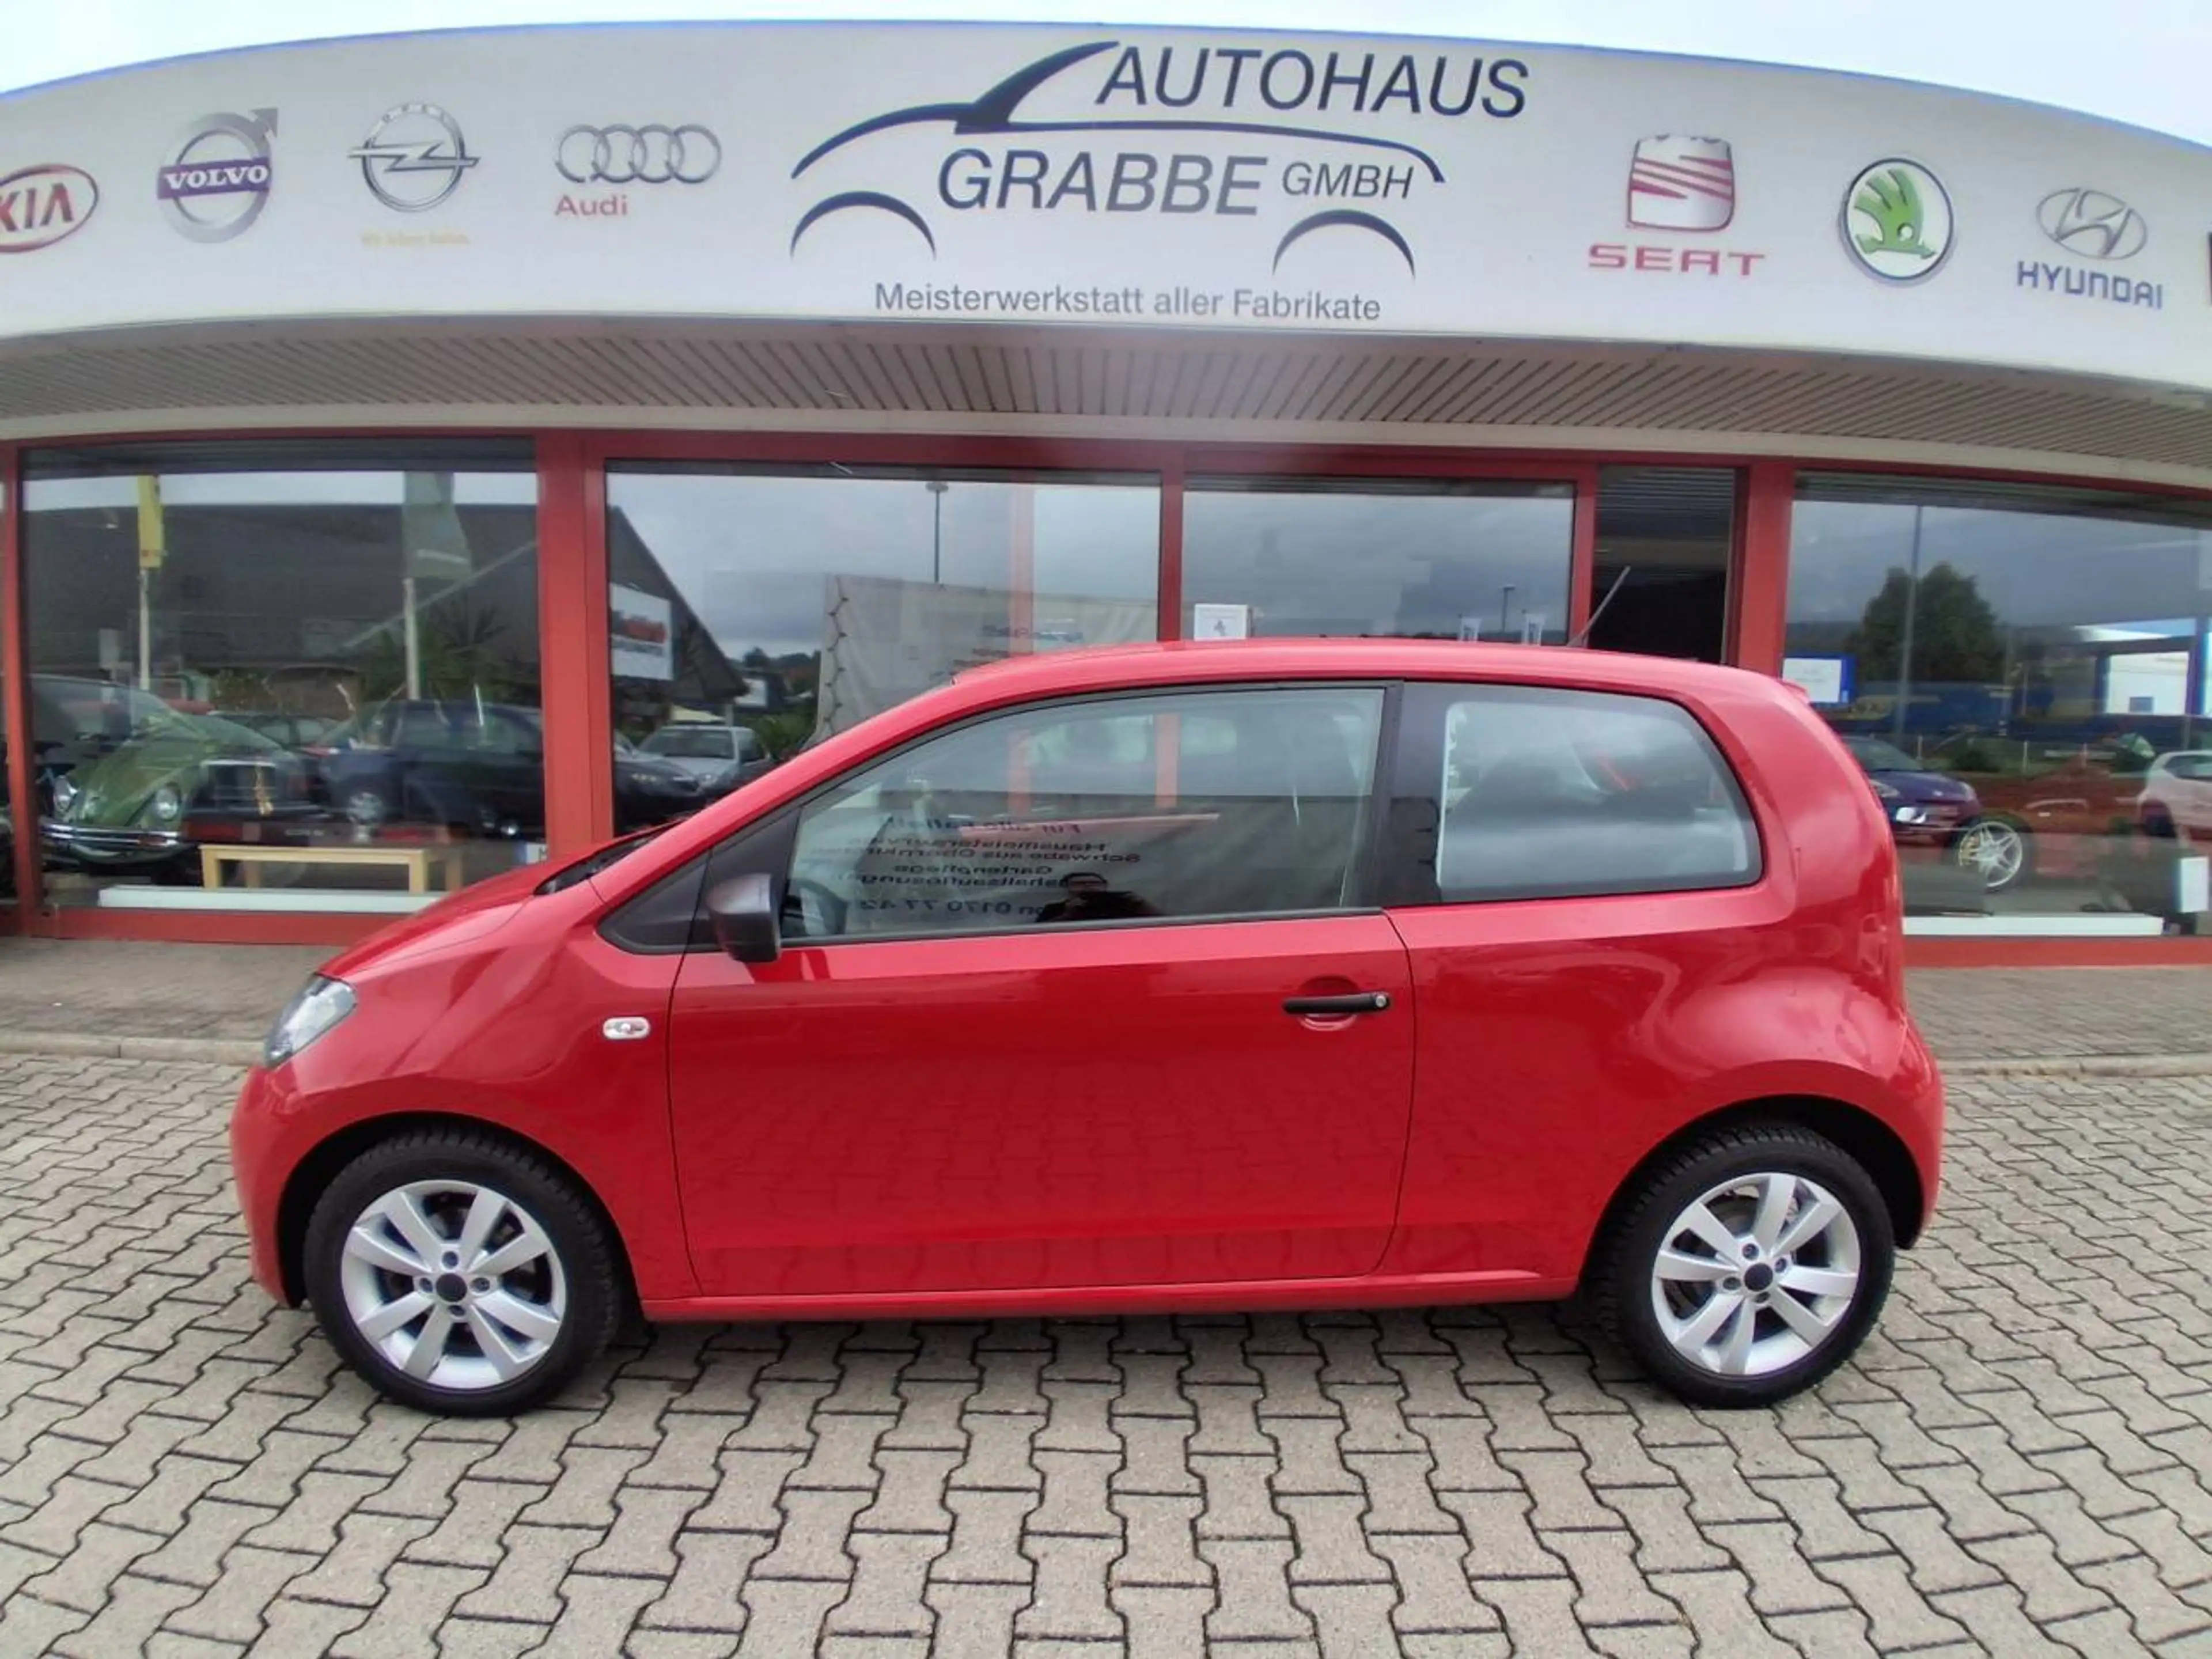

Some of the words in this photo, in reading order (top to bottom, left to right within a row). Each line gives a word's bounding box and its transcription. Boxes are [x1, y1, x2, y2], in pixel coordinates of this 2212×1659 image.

[1096, 46, 1529, 118] AUTOHAUS
[165, 166, 269, 191] VOLVO
[938, 148, 1268, 215] GRABBE
[1282, 162, 1415, 199] GMBH
[0, 183, 73, 232] KIA
[555, 195, 629, 216] Audi
[1589, 244, 1765, 276] SEAT
[875, 283, 1143, 316] Meisterwerkstatt
[1154, 287, 1224, 317] aller
[1233, 289, 1381, 321] Fabrikate
[2017, 260, 2163, 310] HYUNDAI
